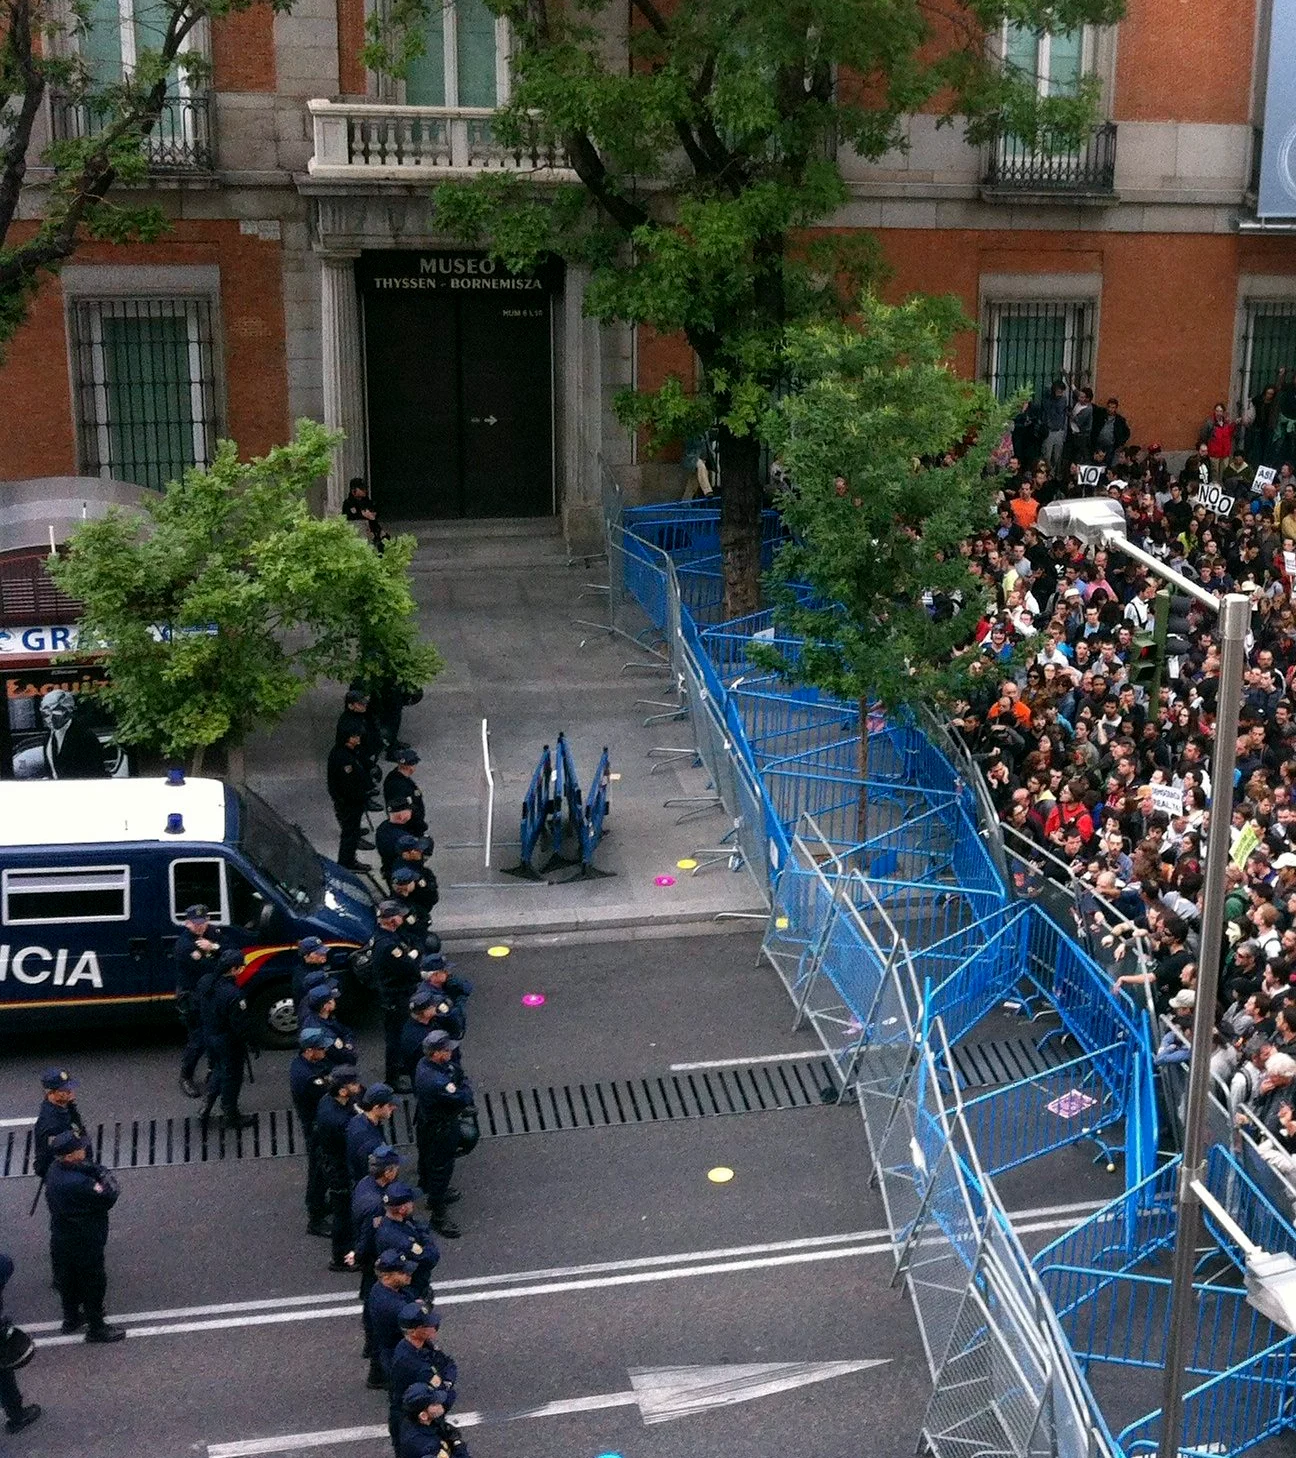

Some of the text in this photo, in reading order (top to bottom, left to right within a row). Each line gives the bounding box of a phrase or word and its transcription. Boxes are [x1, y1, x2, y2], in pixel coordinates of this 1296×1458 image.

[420, 258, 496, 274] MUSEO
[374, 278, 436, 289] THYSSEN
[450, 278, 543, 290] BORNEMISZA
[1200, 486, 1219, 505] NO
